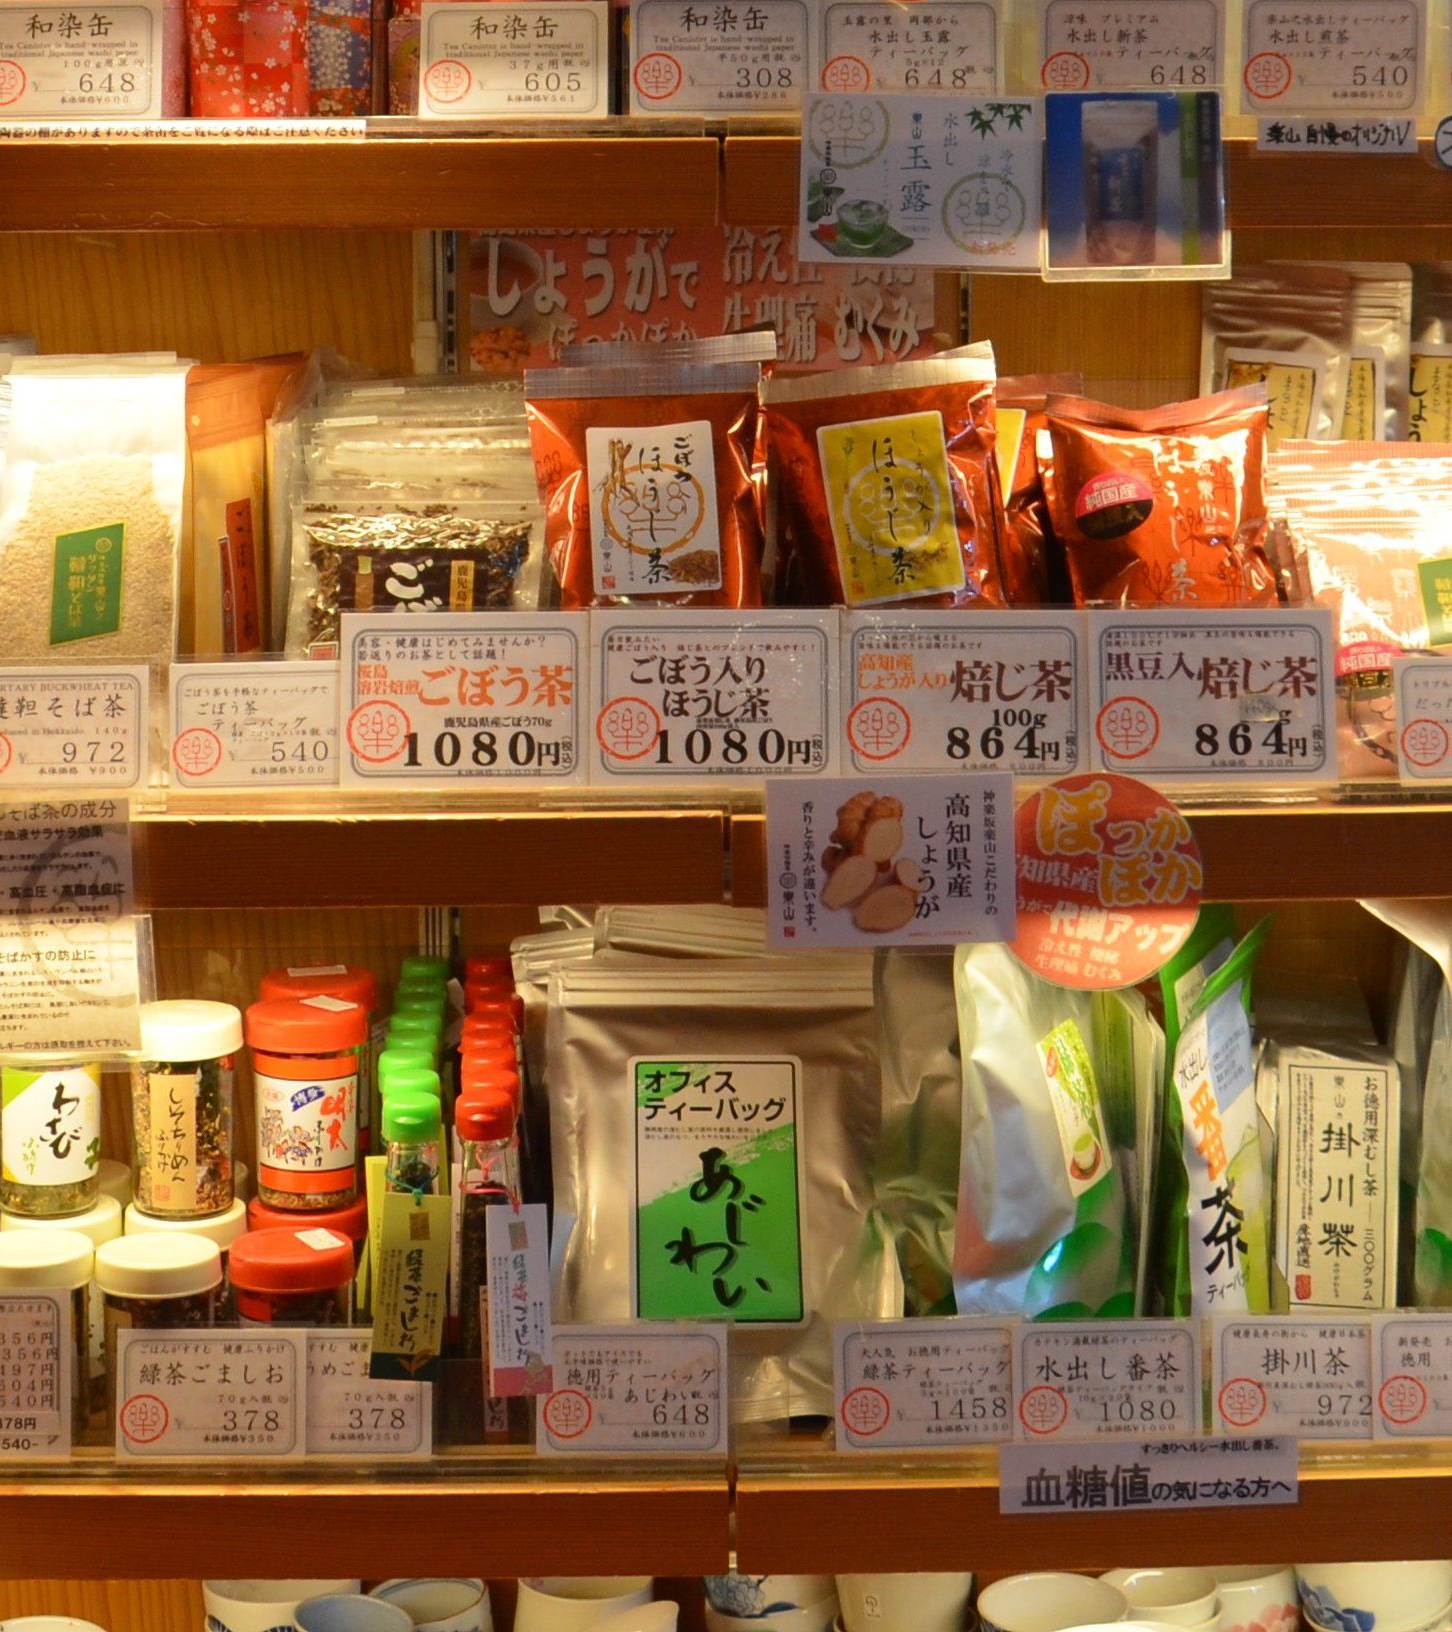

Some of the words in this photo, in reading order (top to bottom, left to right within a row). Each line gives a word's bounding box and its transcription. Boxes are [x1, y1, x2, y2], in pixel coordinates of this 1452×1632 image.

[26, 12, 113, 40] 和染缶
[470, 14, 559, 40] 和染缶
[681, 6, 769, 31] 和染缶
[868, 30, 951, 45] 水出し玉露
[1066, 28, 1148, 44] 水出し新茶
[1269, 29, 1350, 44] 水出し煎茶
[524, 71, 582, 93] 605
[736, 67, 793, 89] 308
[487, 236, 700, 316] しょうがで
[638, 447, 673, 585] ほうじ茶
[871, 436, 918, 584] ほうじ茶
[357, 663, 388, 679] 桜島
[628, 654, 767, 686] ごぼう入り
[857, 652, 915, 672] 高知産
[40, 682, 112, 692] BUCKWHEAT
[114, 682, 134, 692] TEA
[357, 678, 421, 696] 溶岩焙煎
[417, 663, 574, 710] ごぼう茶
[858, 669, 949, 690] しょうが入り
[949, 659, 1073, 705] 焙じ茶
[1105, 651, 1195, 683] 黒豆入
[1198, 655, 1319, 702] 焙じ茶
[196, 699, 258, 716] ごぼう茶
[662, 688, 771, 719] ほうじ茶
[444, 715, 553, 730] 鹿児島県産ごぼう70g
[991, 707, 1048, 730] 100g
[60, 740, 126, 764] 972
[403, 732, 560, 769] 1080円
[655, 727, 812, 766] 1080円
[946, 726, 1061, 763] 864円
[1195, 719, 1308, 759] 864円
[1037, 785, 1192, 857] ぽっか
[944, 793, 974, 901] 高知県産
[913, 816, 941, 919] しょうが
[1098, 852, 1200, 906] ぽか
[1047, 899, 1190, 955] 代謝アップ
[643, 1070, 737, 1095] オフィス
[40, 1082, 84, 1160] わさび
[643, 1097, 787, 1124] ティーバッグ
[1361, 1074, 1381, 1199] お徳用深むし茶
[1189, 1079, 1251, 1278] 番茶
[1319, 1122, 1360, 1260] 掛川茶
[664, 1146, 774, 1310] あじわい
[1, 1347, 59, 1362] 356円
[1034, 1352, 1179, 1381] 水出し番茶
[1262, 1348, 1351, 1376] 掛川茶
[139, 1363, 284, 1385] 緑茶ごましお
[565, 1367, 719, 1388] 徳用ティーバッグ
[863, 1360, 1009, 1380] 緑茶ティーバッグ
[931, 1397, 1008, 1419] 1458
[1099, 1399, 1177, 1422] 1080
[1317, 1393, 1372, 1416] 972
[222, 1409, 281, 1432] 378
[348, 1408, 407, 1431] 378
[1021, 1465, 1291, 1508] 血糖値の気になる方へ
